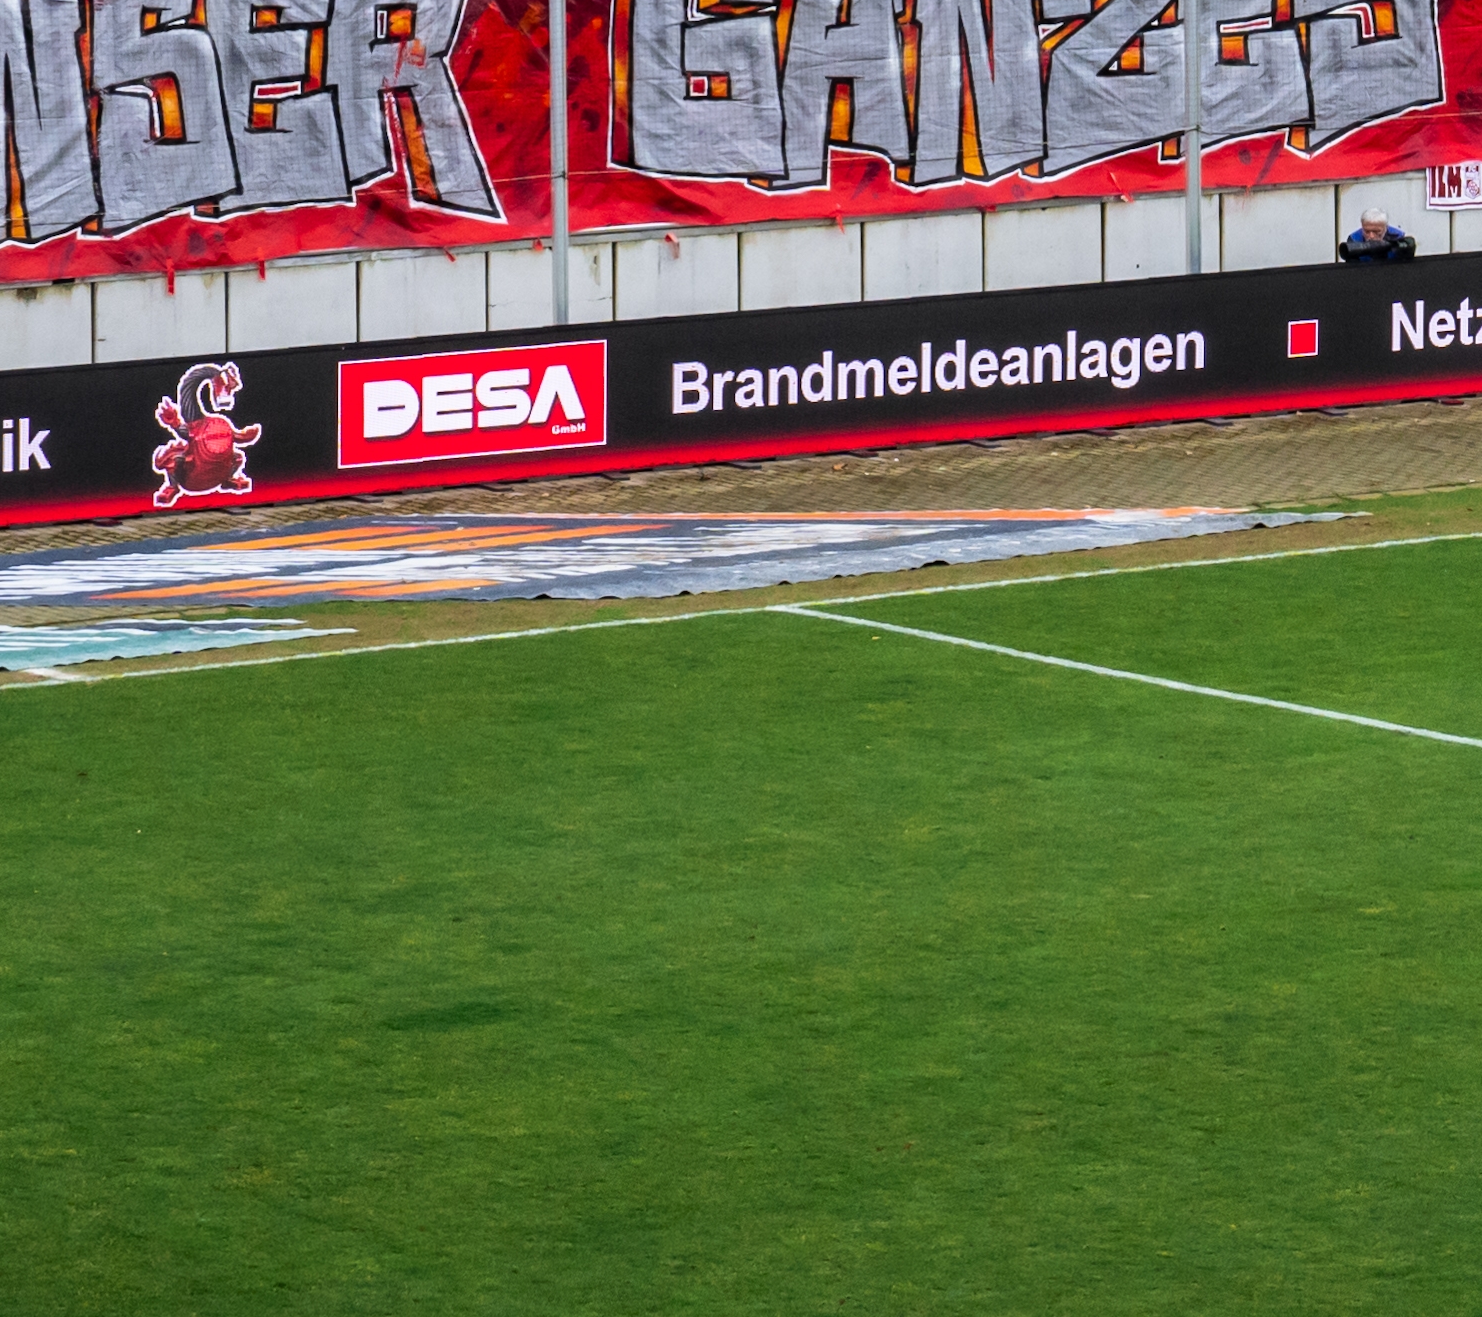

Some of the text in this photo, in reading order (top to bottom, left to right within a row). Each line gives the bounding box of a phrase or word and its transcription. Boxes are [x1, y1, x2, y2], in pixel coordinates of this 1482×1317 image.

[1429, 166, 1461, 200] ILM
[672, 330, 1205, 414] Brandmeldeanlagen
[363, 364, 586, 438] DESA
[551, 421, 586, 436] GmbH
